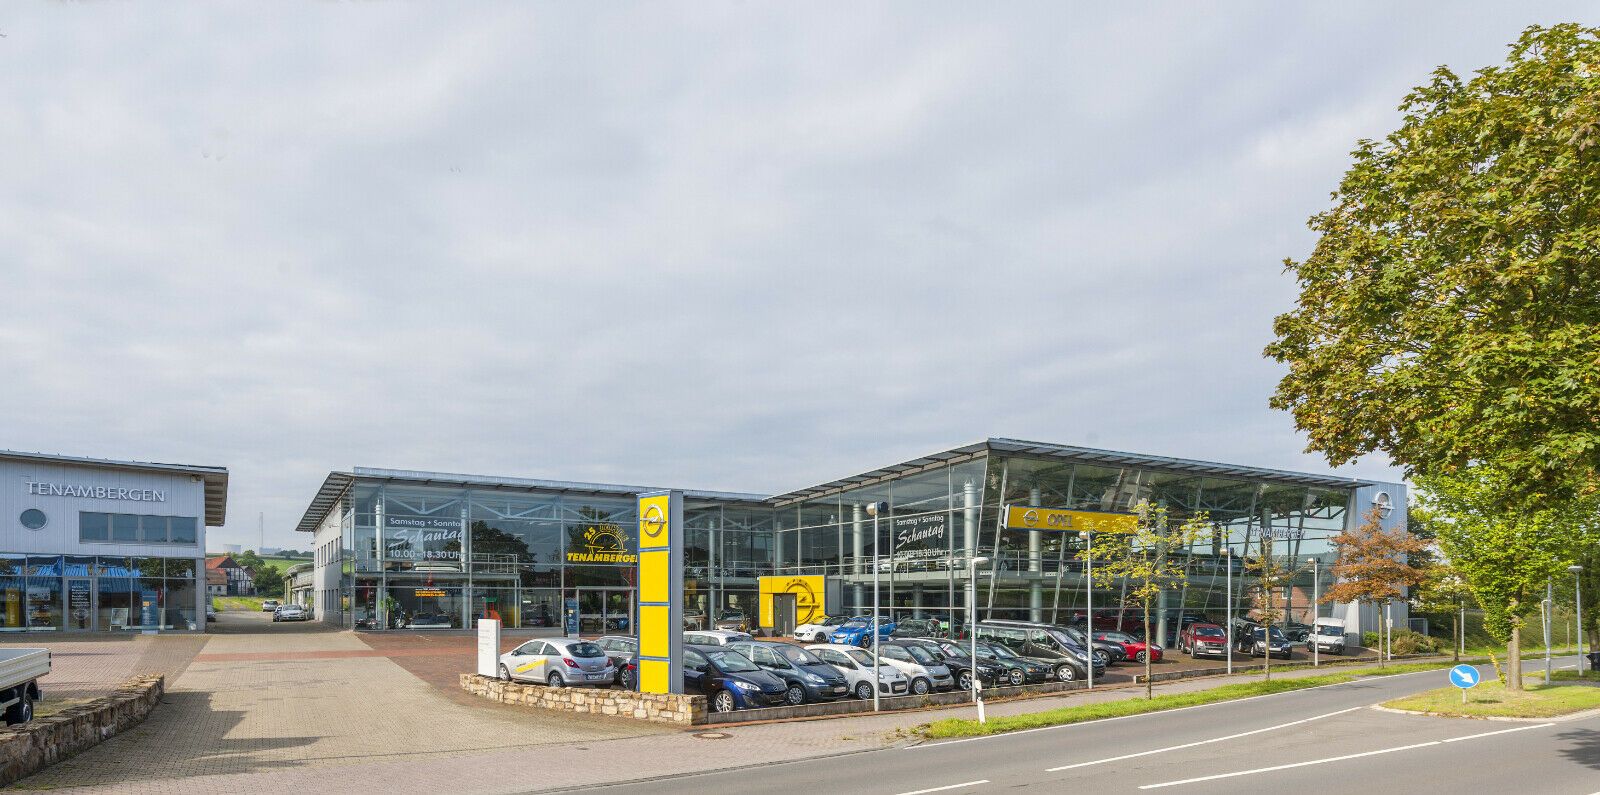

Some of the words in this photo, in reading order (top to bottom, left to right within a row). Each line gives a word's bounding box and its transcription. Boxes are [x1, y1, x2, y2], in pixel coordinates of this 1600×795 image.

[25, 481, 166, 502] TENAMBERGEN
[390, 517, 426, 527] Samstag
[433, 519, 465, 527] Sonnta
[583, 526, 597, 541] 25
[895, 524, 945, 550] Schautag
